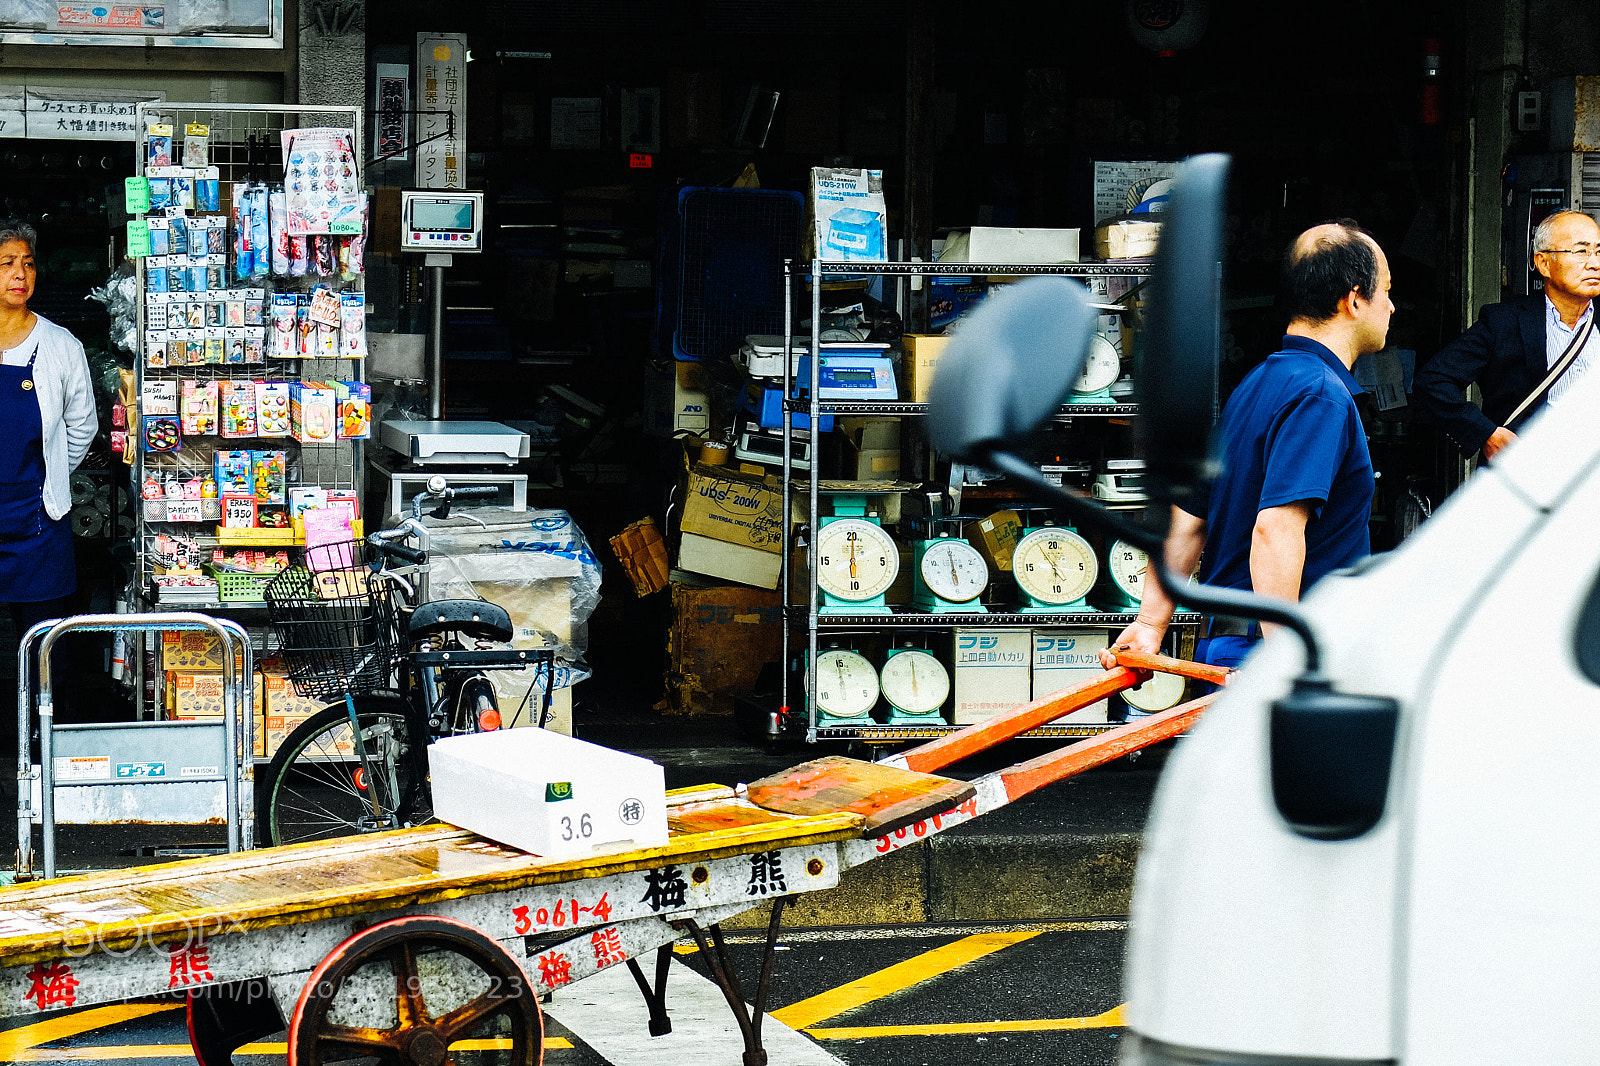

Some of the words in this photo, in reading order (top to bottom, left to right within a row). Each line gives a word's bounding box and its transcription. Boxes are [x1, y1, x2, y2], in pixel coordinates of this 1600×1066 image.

[818, 181, 857, 190] UDS-210W
[847, 531, 857, 541] 20
[1048, 541, 1058, 550] 20
[820, 556, 830, 566] 15
[879, 556, 886, 567] 5
[1123, 552, 1133, 561] 25
[1025, 563, 1034, 572] 15
[1078, 562, 1084, 571] 5
[1128, 574, 1138, 583] 20
[850, 581, 860, 591] 10
[1052, 585, 1061, 593] 10
[958, 636, 998, 649] フジ
[1036, 638, 1076, 652] フジ
[958, 652, 1025, 663] 上皿自動ハカリ
[835, 659, 844, 668] 15
[820, 691, 829, 700] 10
[862, 689, 868, 698] 5
[622, 801, 641, 821] 特
[560, 812, 593, 841] 3.6
[746, 850, 788, 895] 熊
[591, 927, 627, 969] 熊
[168, 939, 214, 988] 熊
